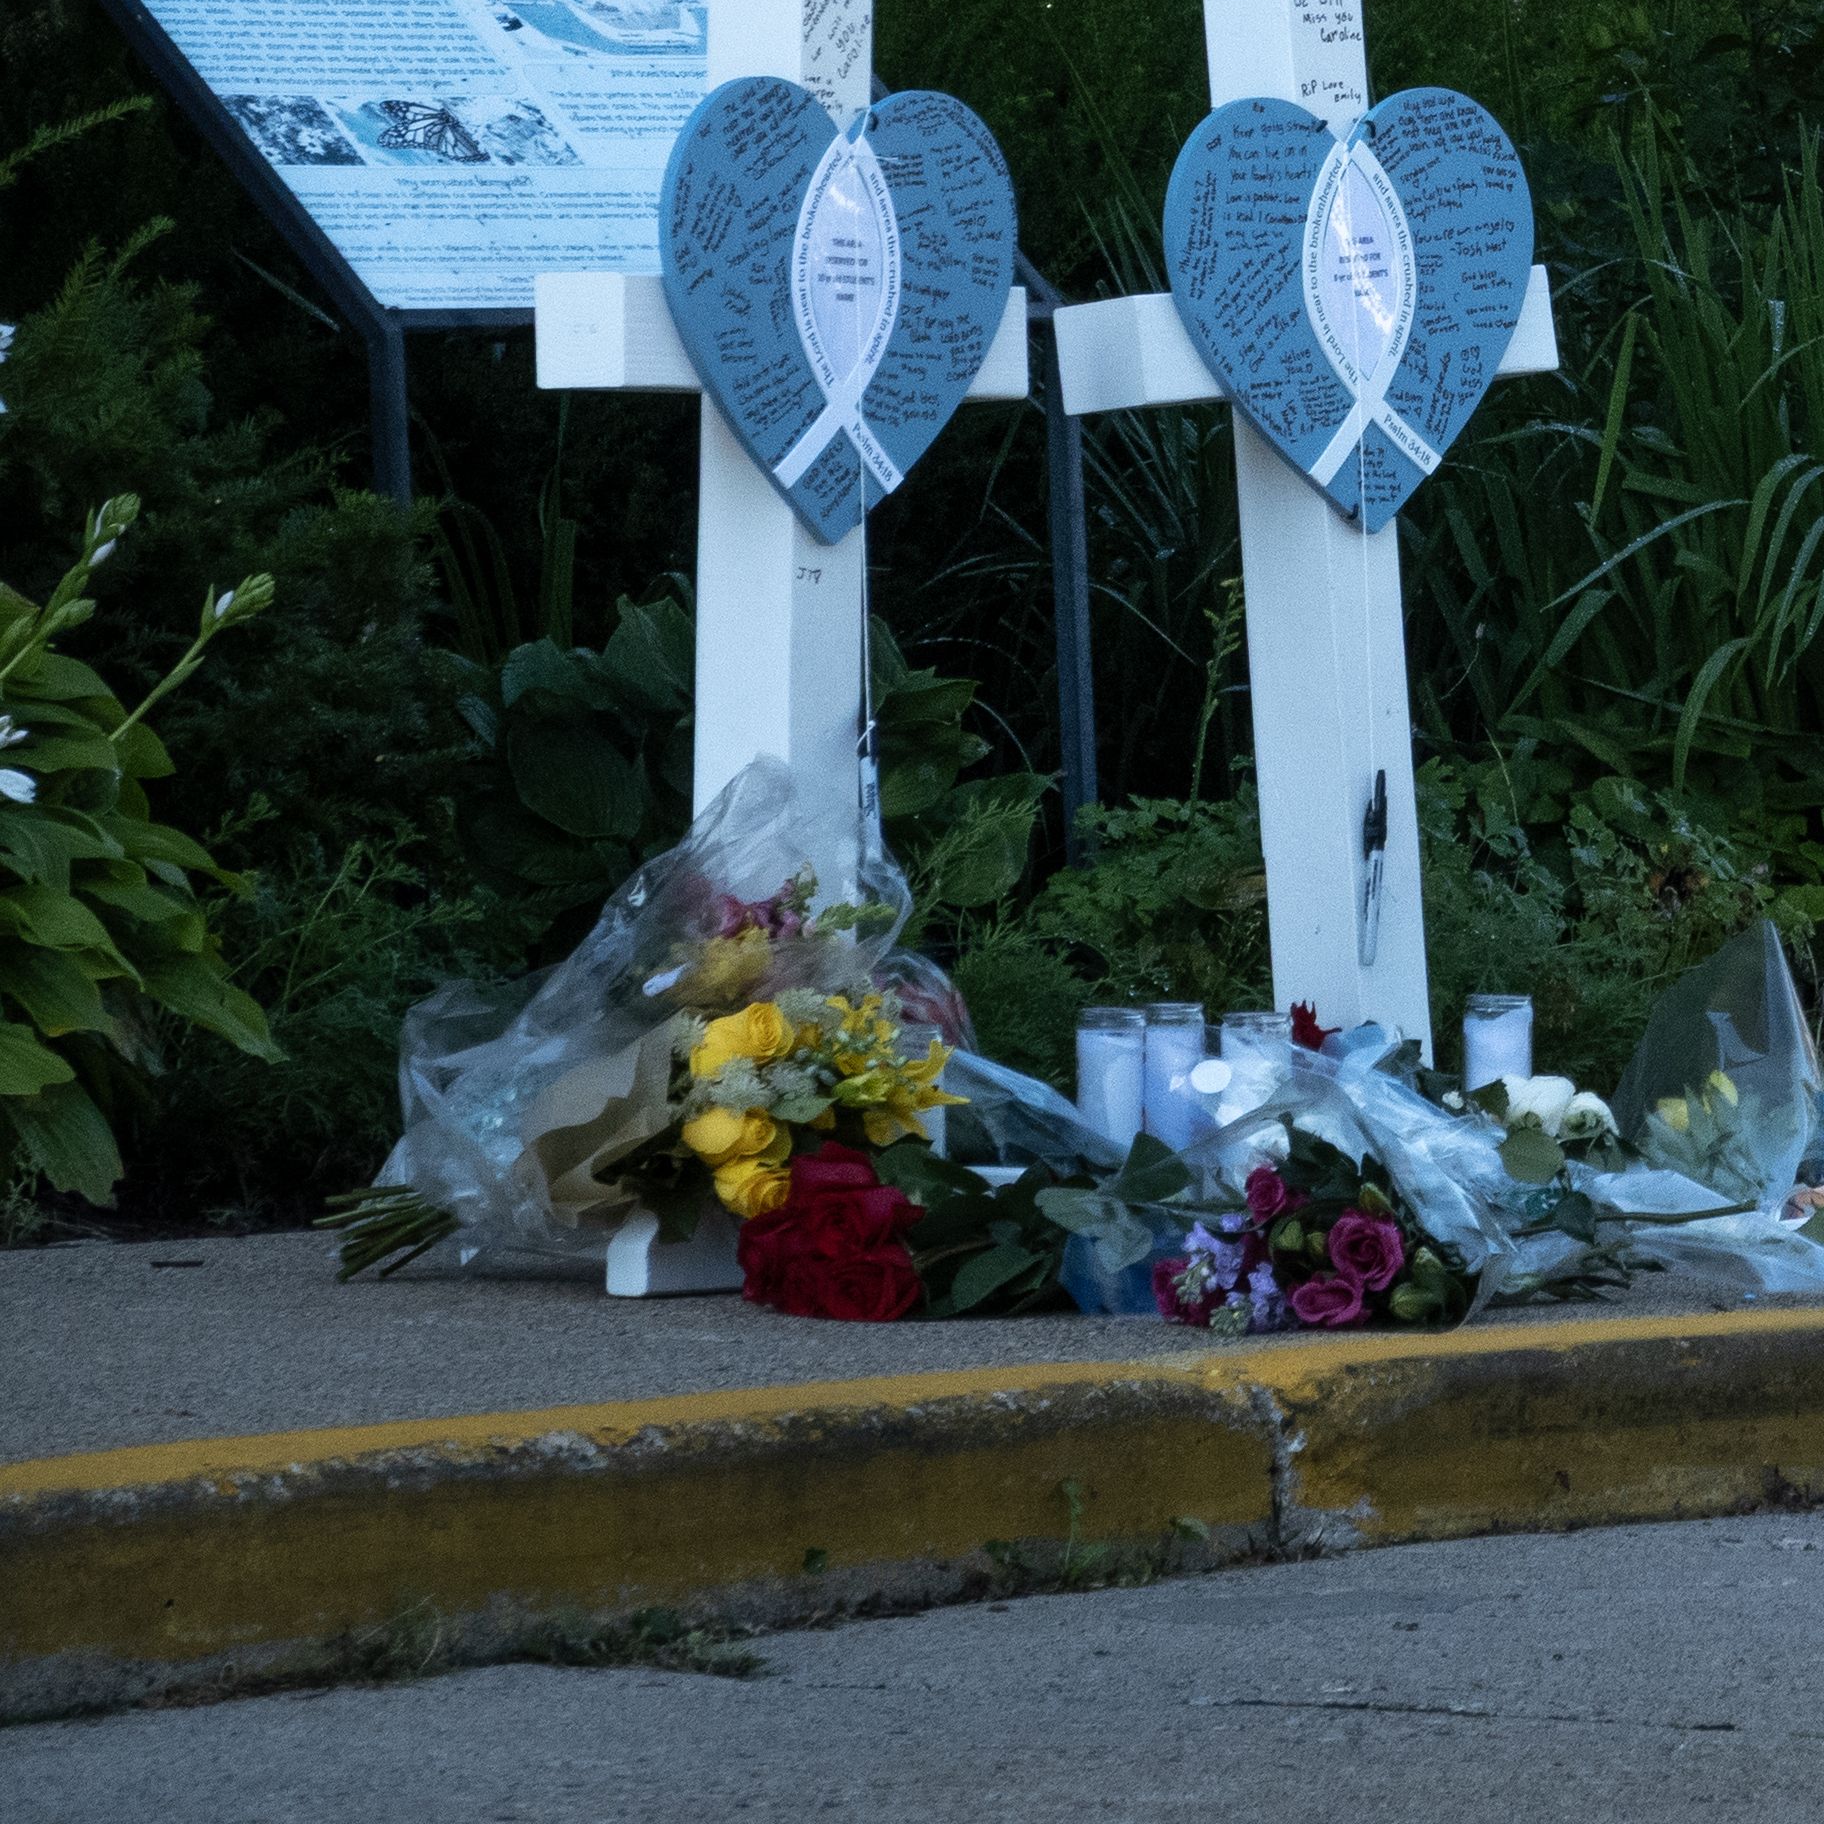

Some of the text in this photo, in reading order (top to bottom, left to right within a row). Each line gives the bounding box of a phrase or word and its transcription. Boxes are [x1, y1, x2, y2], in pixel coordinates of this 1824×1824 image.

[1334, 12, 1354, 25] you
[1320, 27, 1362, 43] Caroline
[1322, 80, 1345, 91] Love
[803, 149, 843, 241] brokenhearted
[870, 173, 884, 196] and
[1373, 173, 1390, 195] and
[1385, 196, 1401, 228] saves
[888, 236, 896, 257] the
[1397, 230, 1408, 252] the
[798, 243, 809, 267] the
[1308, 158, 1359, 385] The Lord is near to the brokenhearted
[1402, 254, 1414, 308] crushed
[885, 260, 897, 317] crushed
[799, 288, 810, 318] near
[1399, 309, 1411, 323] in
[807, 333, 824, 364] Lord
[820, 365, 835, 388] The
[1382, 413, 1432, 467] Psalm 34:18
[852, 422, 873, 457] Psalm
[871, 452, 894, 483] 34:18
